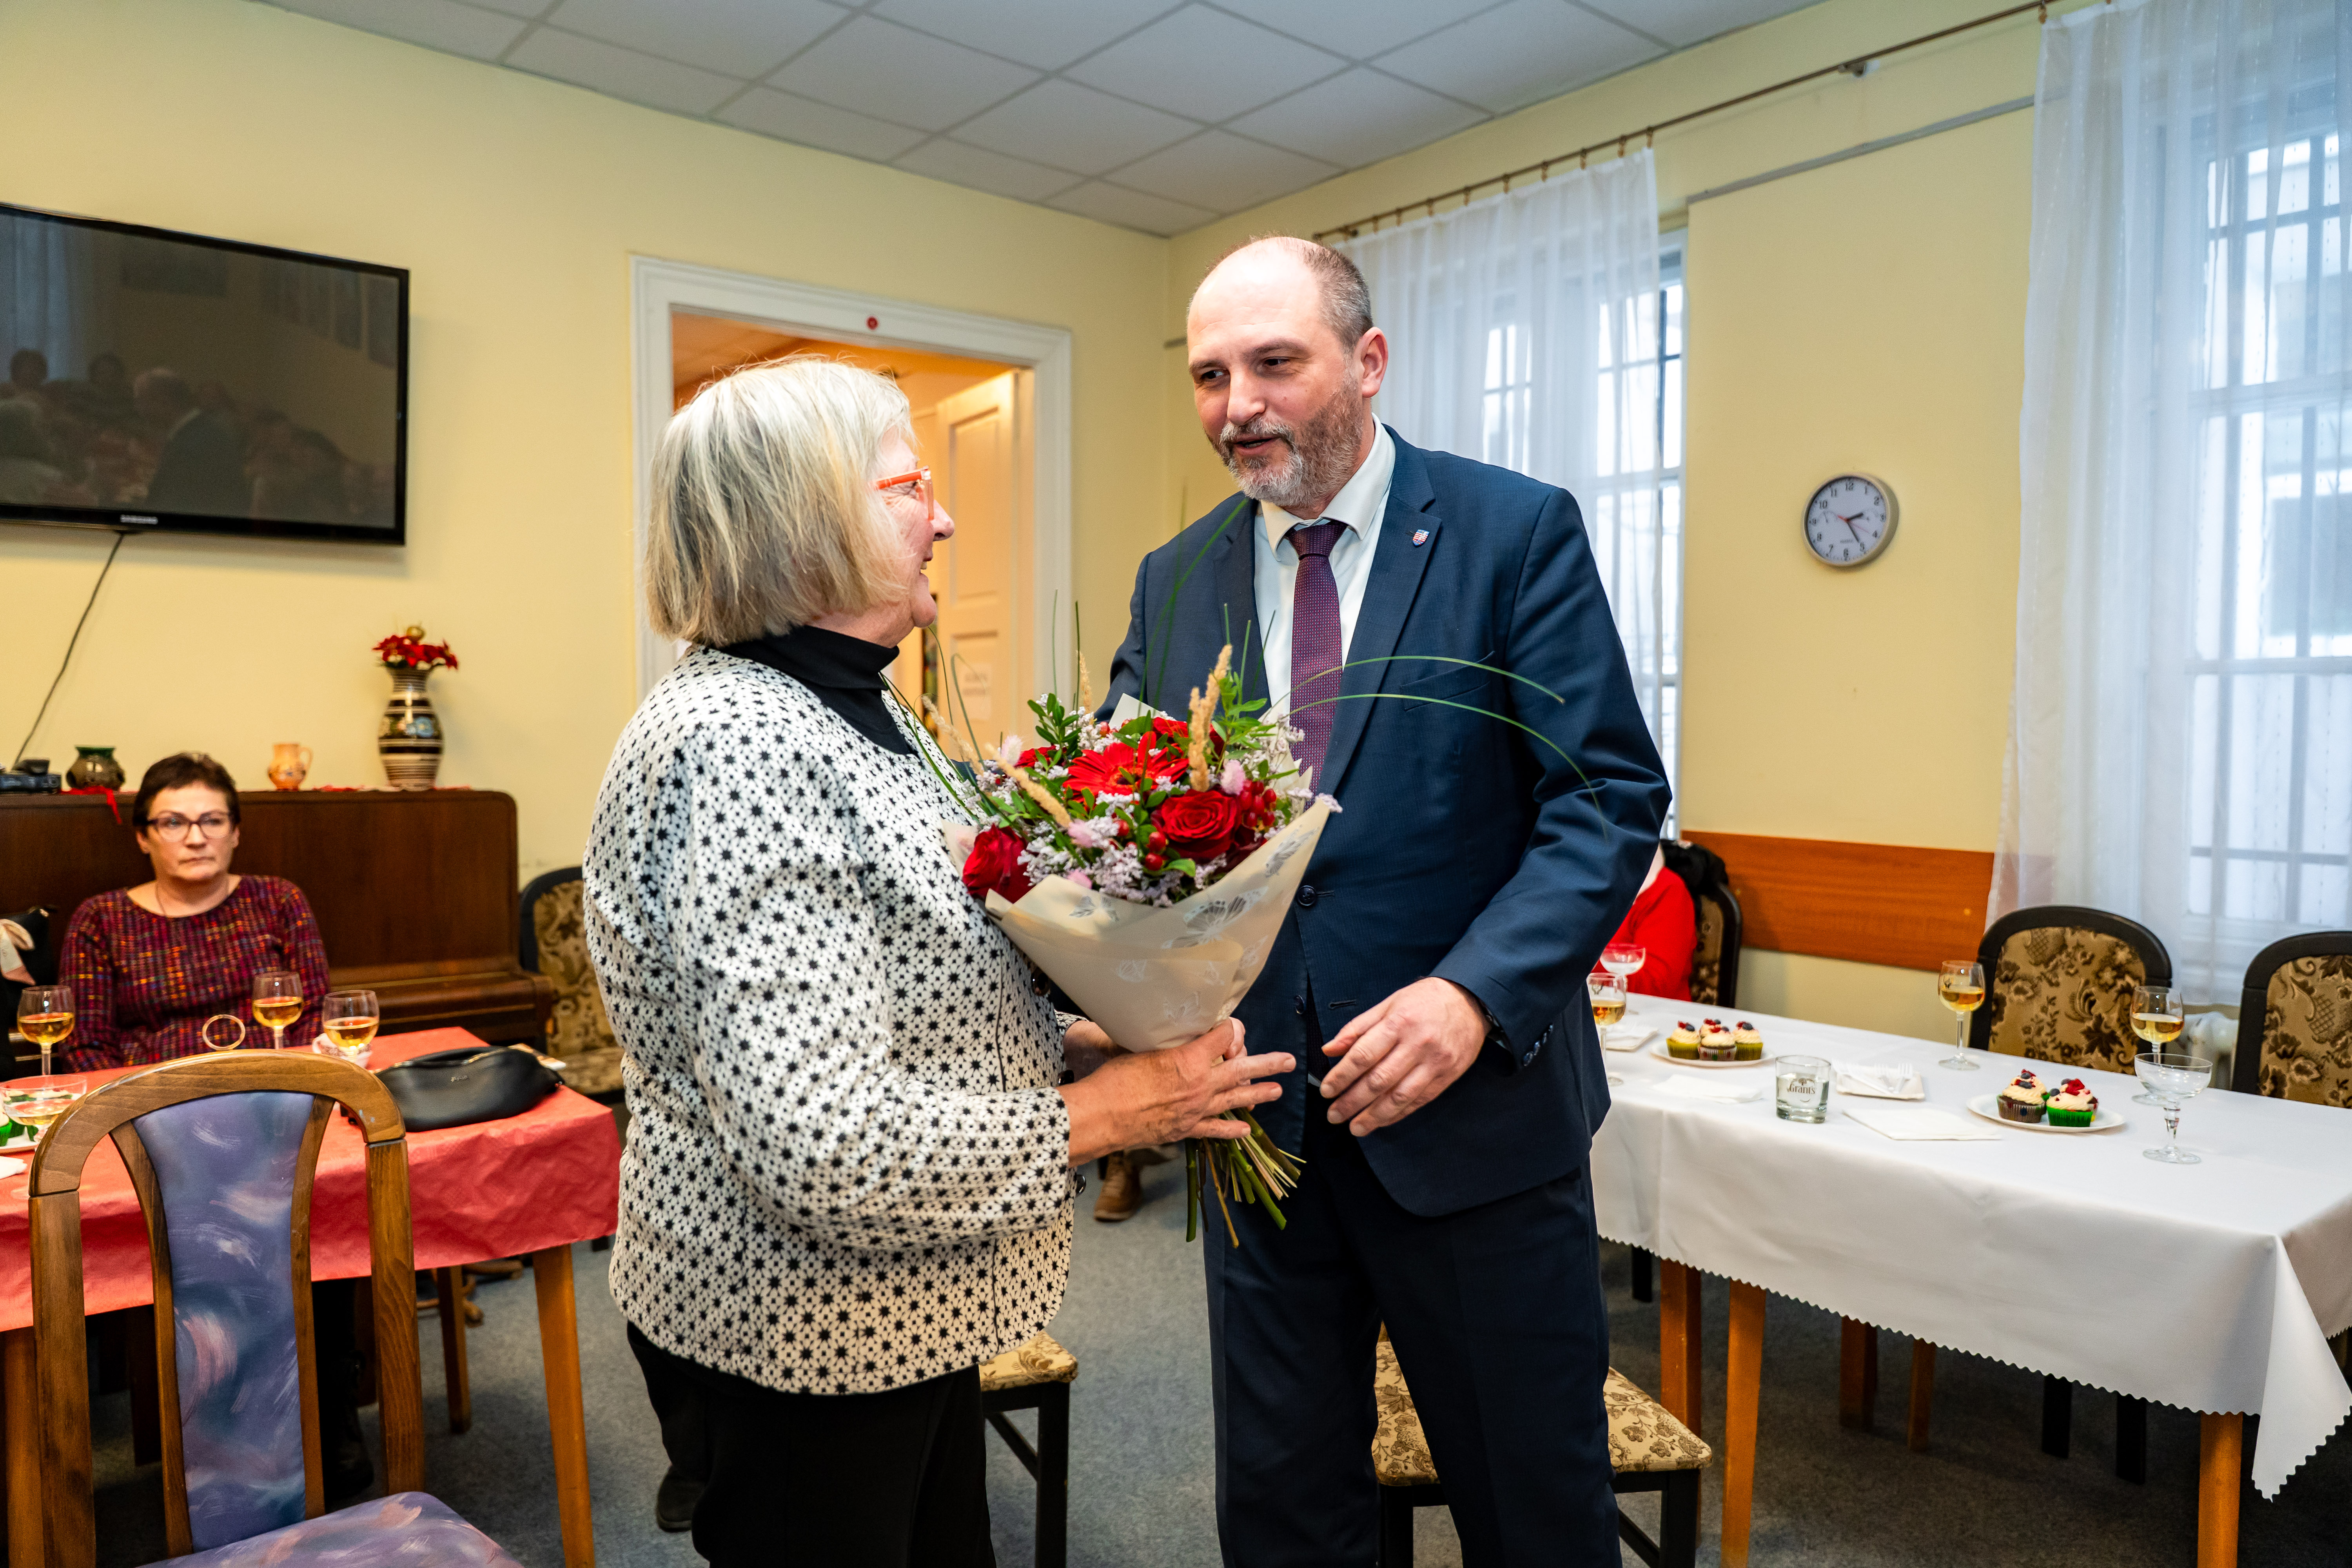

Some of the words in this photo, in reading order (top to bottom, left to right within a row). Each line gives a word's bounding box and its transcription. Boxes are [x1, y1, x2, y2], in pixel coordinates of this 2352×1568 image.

[1845, 482, 1854, 491] 12
[1865, 486, 1868, 495] 1
[1831, 488, 1837, 497] 11
[1819, 499, 1828, 509] 10
[1874, 496, 1879, 506] 2
[1817, 532, 1822, 542] 8
[1828, 544, 1833, 554] 7
[1860, 541, 1865, 552] 5
[1843, 548, 1849, 557] 6
